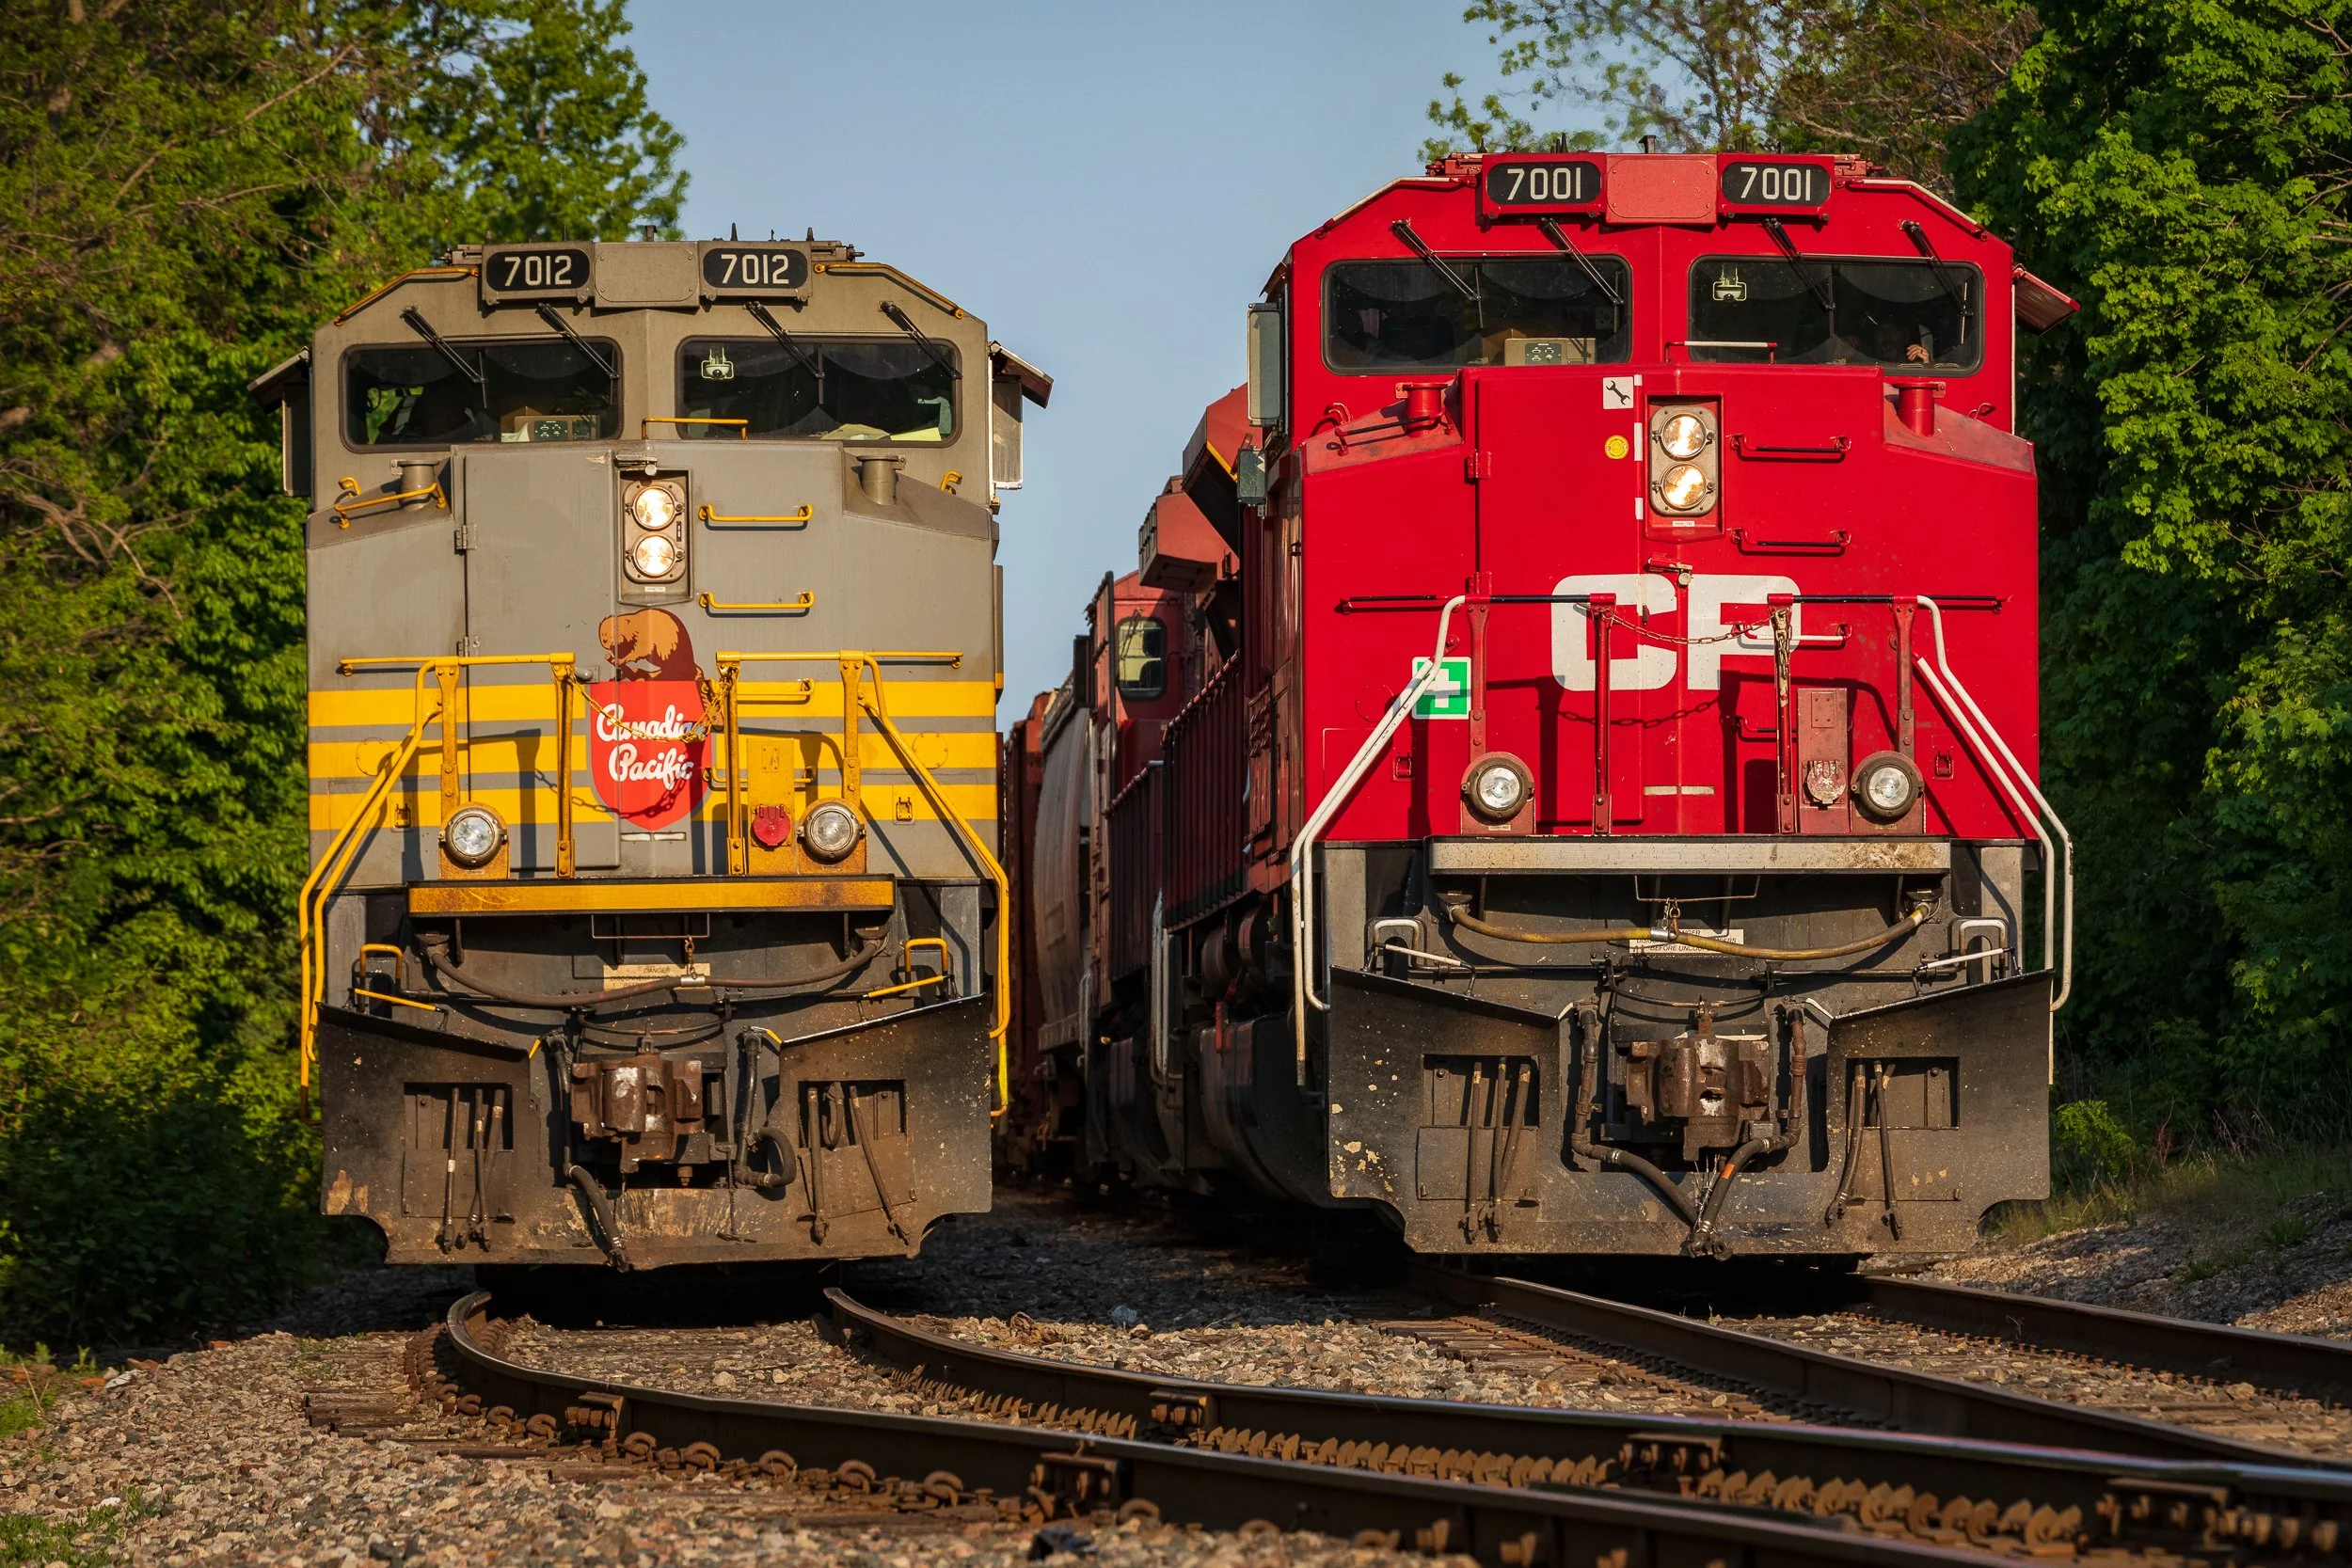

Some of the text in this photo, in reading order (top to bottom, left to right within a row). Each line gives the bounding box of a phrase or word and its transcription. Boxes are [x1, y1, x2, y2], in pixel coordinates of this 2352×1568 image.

[1506, 167, 1581, 200] 7001
[1740, 166, 1811, 201] 7001
[504, 255, 572, 287] 7012
[721, 253, 789, 284] 7012
[1550, 574, 1802, 691] CP
[608, 743, 693, 791] Pacific
